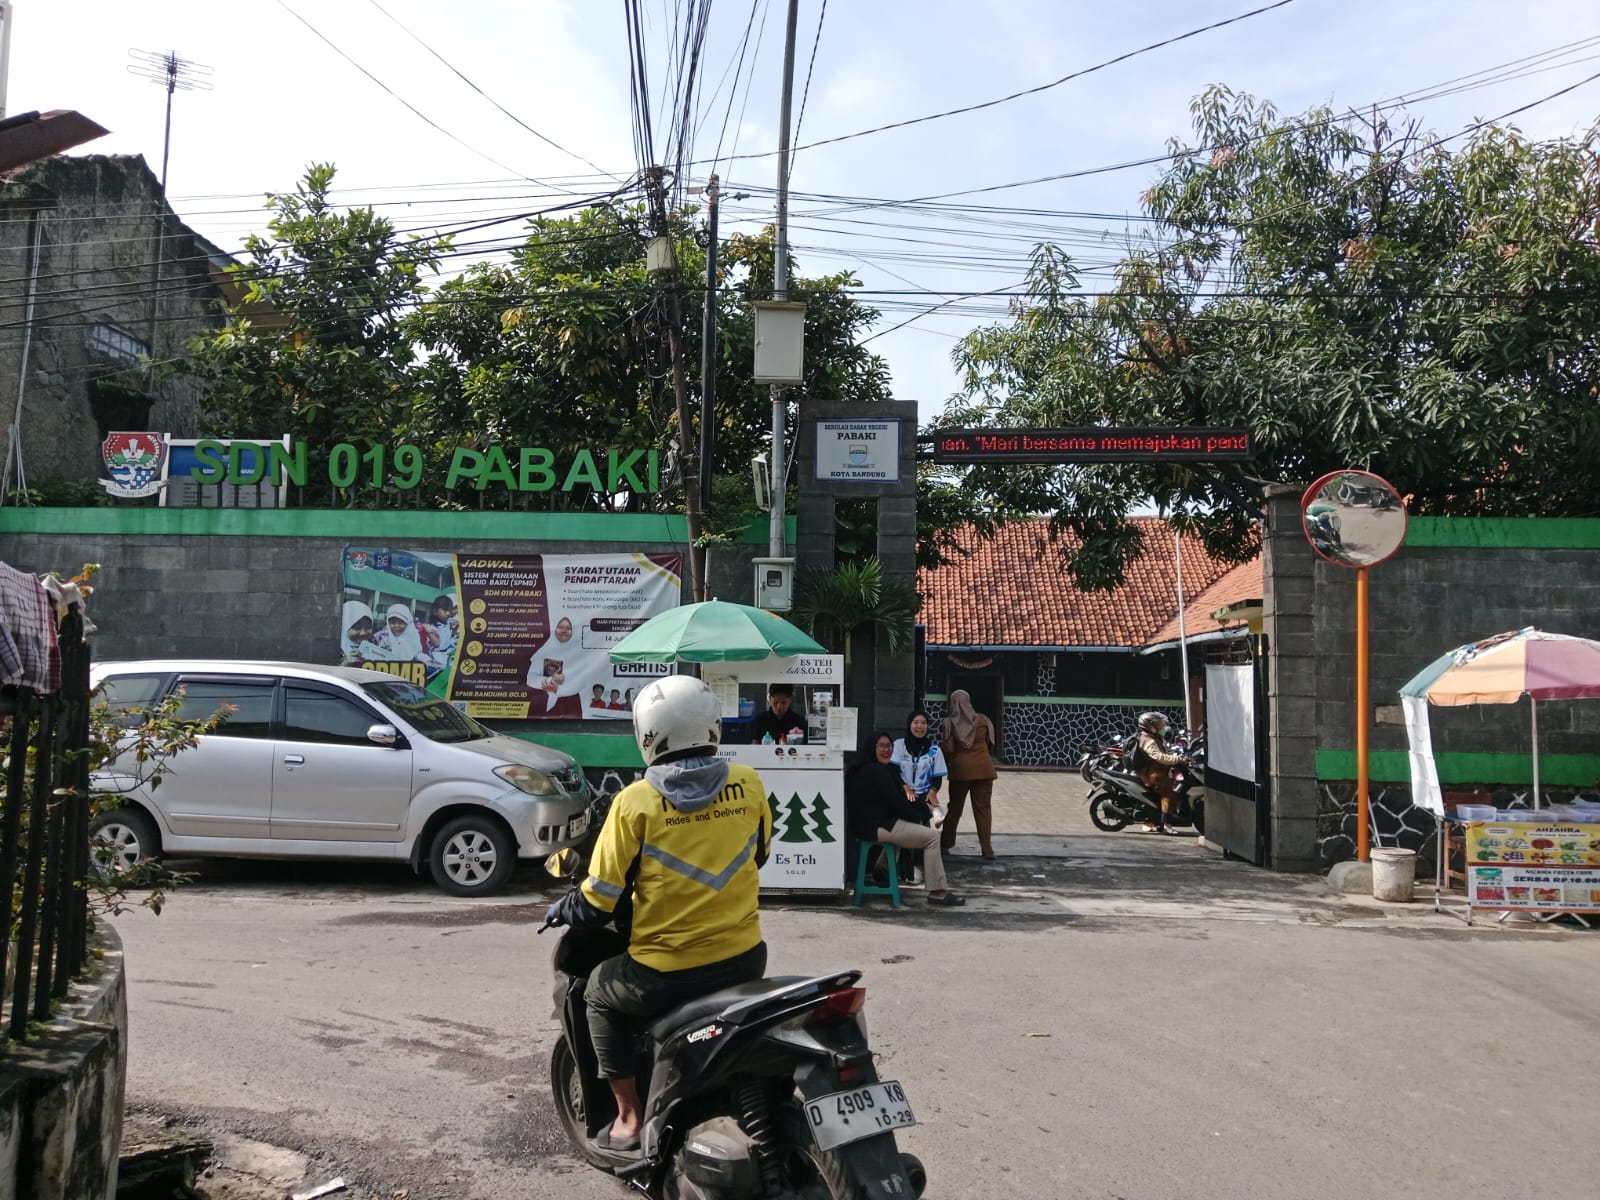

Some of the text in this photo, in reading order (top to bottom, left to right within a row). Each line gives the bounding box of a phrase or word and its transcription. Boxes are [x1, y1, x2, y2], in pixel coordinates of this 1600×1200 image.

[837, 432, 877, 440] PABAKI
[975, 435, 1018, 450] "Mari
[1023, 435, 1096, 450] bersama
[1101, 434, 1201, 453] memajukan
[190, 439, 660, 494] SDN 019 PABAKI
[461, 560, 514, 568] JADWAL
[564, 566, 641, 575] SYARAT UTAMA
[564, 576, 637, 584] PENDAFTARAN
[800, 658, 832, 666] ES TEH
[664, 806, 747, 826] Rides and Delivery
[775, 853, 817, 864] Es Teh
[810, 1105, 823, 1127] D
[836, 1090, 874, 1116] 4909
